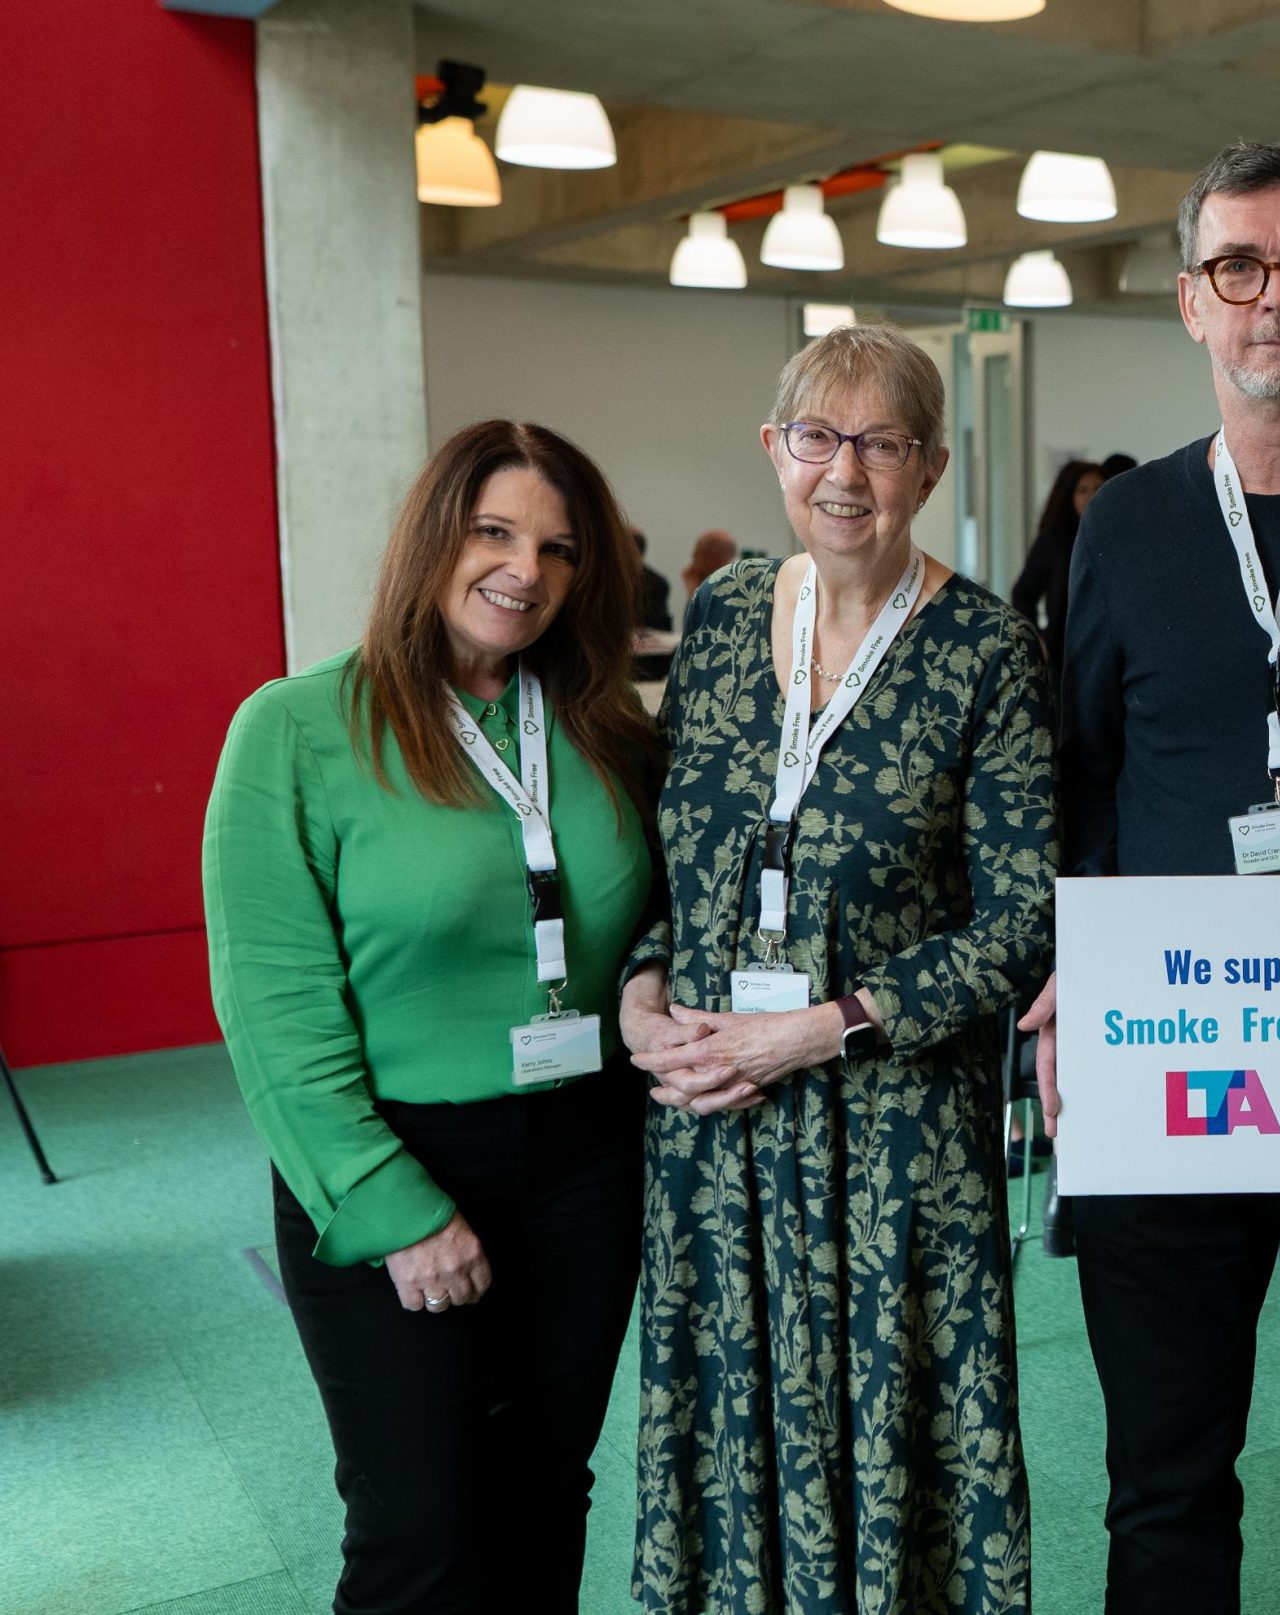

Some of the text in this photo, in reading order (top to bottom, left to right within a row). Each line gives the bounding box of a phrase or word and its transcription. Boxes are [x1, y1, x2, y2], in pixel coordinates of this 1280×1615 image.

[1224, 473, 1236, 508] Smoke Free
[858, 635, 884, 673] Smoke Free
[790, 712, 801, 750] Smoke Free
[1250, 850, 1267, 858] David
[1164, 949, 1212, 985] We
[1104, 1008, 1219, 1045] Smoke
